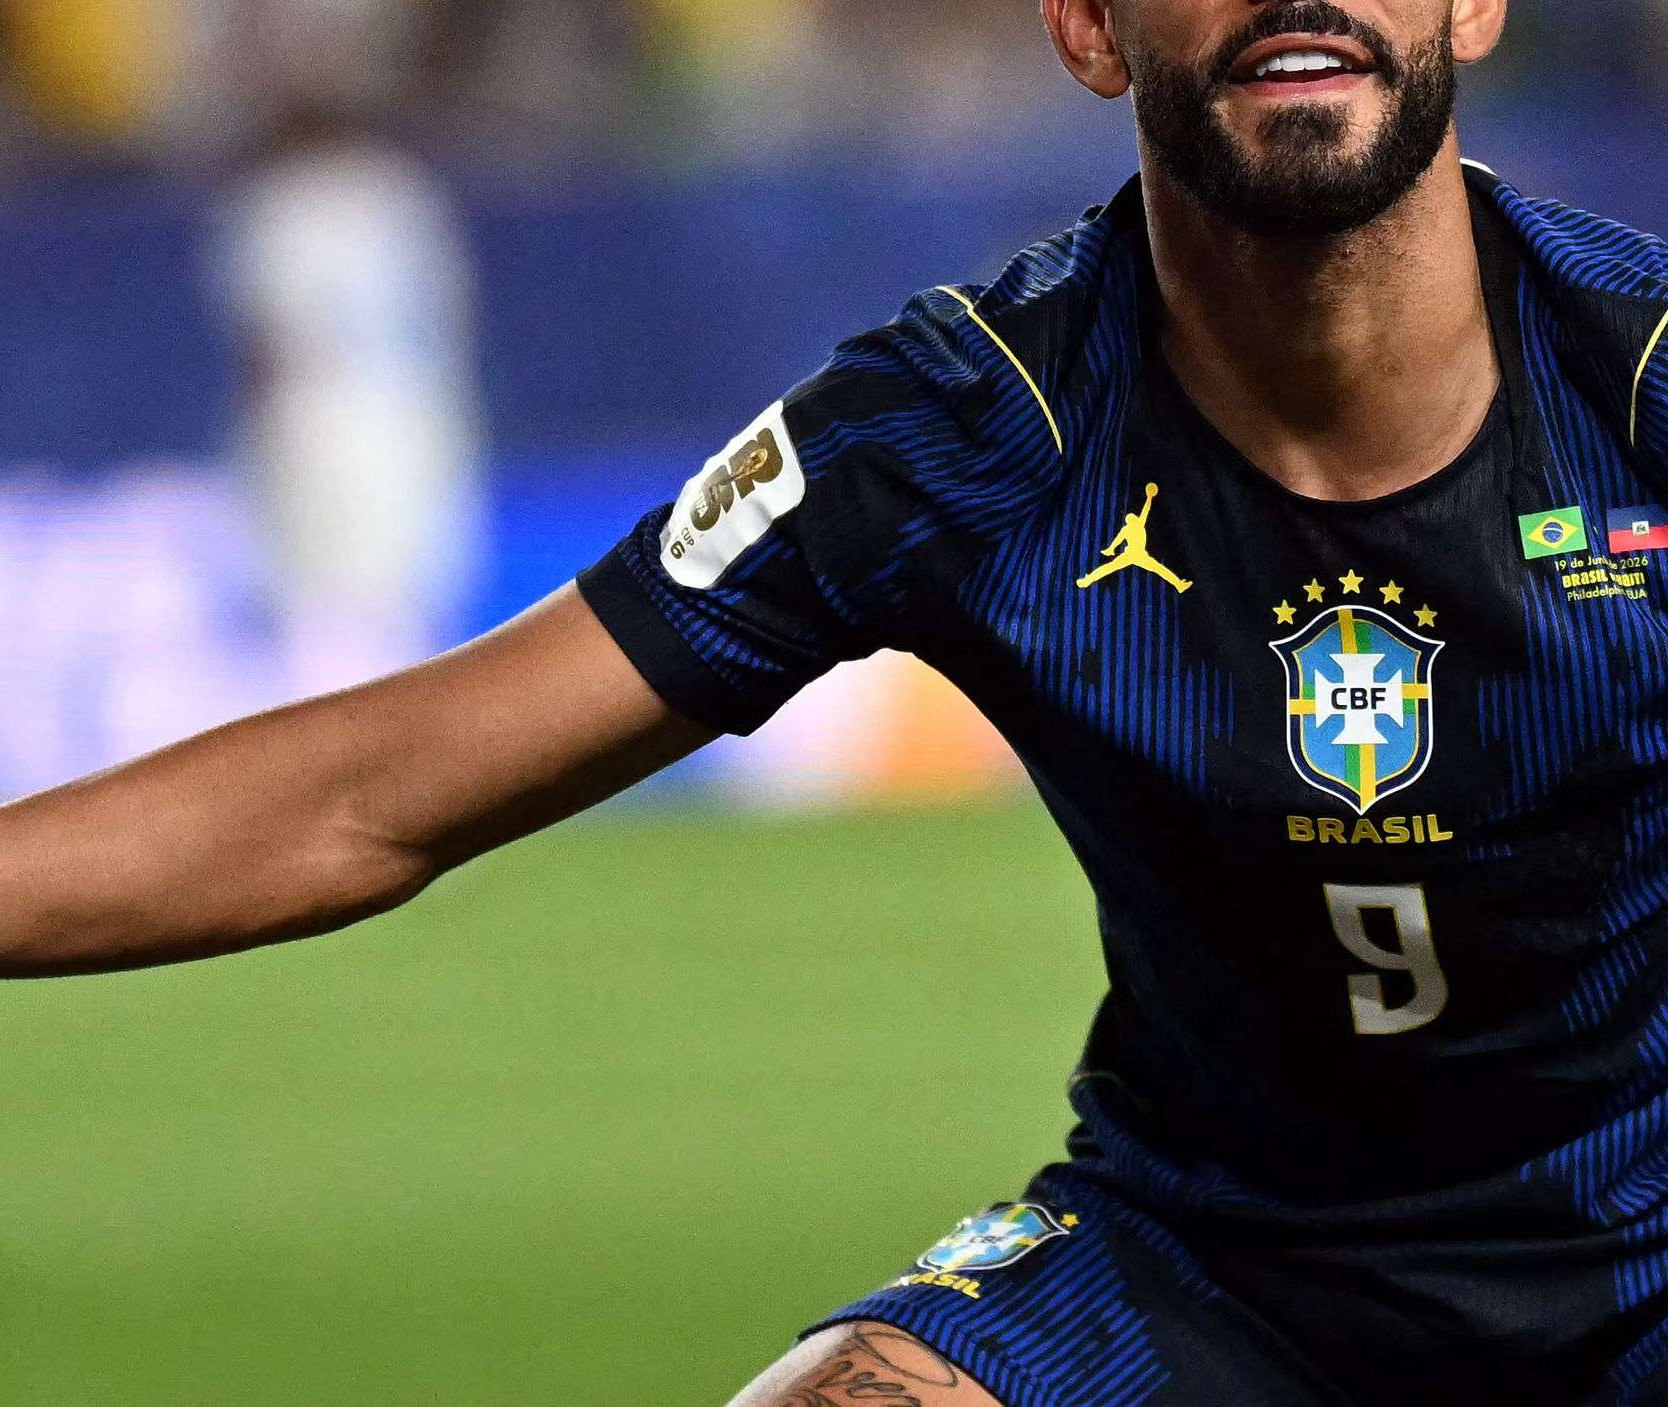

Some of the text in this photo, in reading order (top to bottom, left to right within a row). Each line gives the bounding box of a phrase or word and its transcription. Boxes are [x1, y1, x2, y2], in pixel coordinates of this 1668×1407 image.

[1554, 559, 1567, 572] 19
[1570, 557, 1584, 568] de
[1620, 556, 1648, 570] 2026
[1331, 687, 1387, 711] CBF
[1286, 814, 1454, 844] BRASIL
[1322, 882, 1450, 1035] 9
